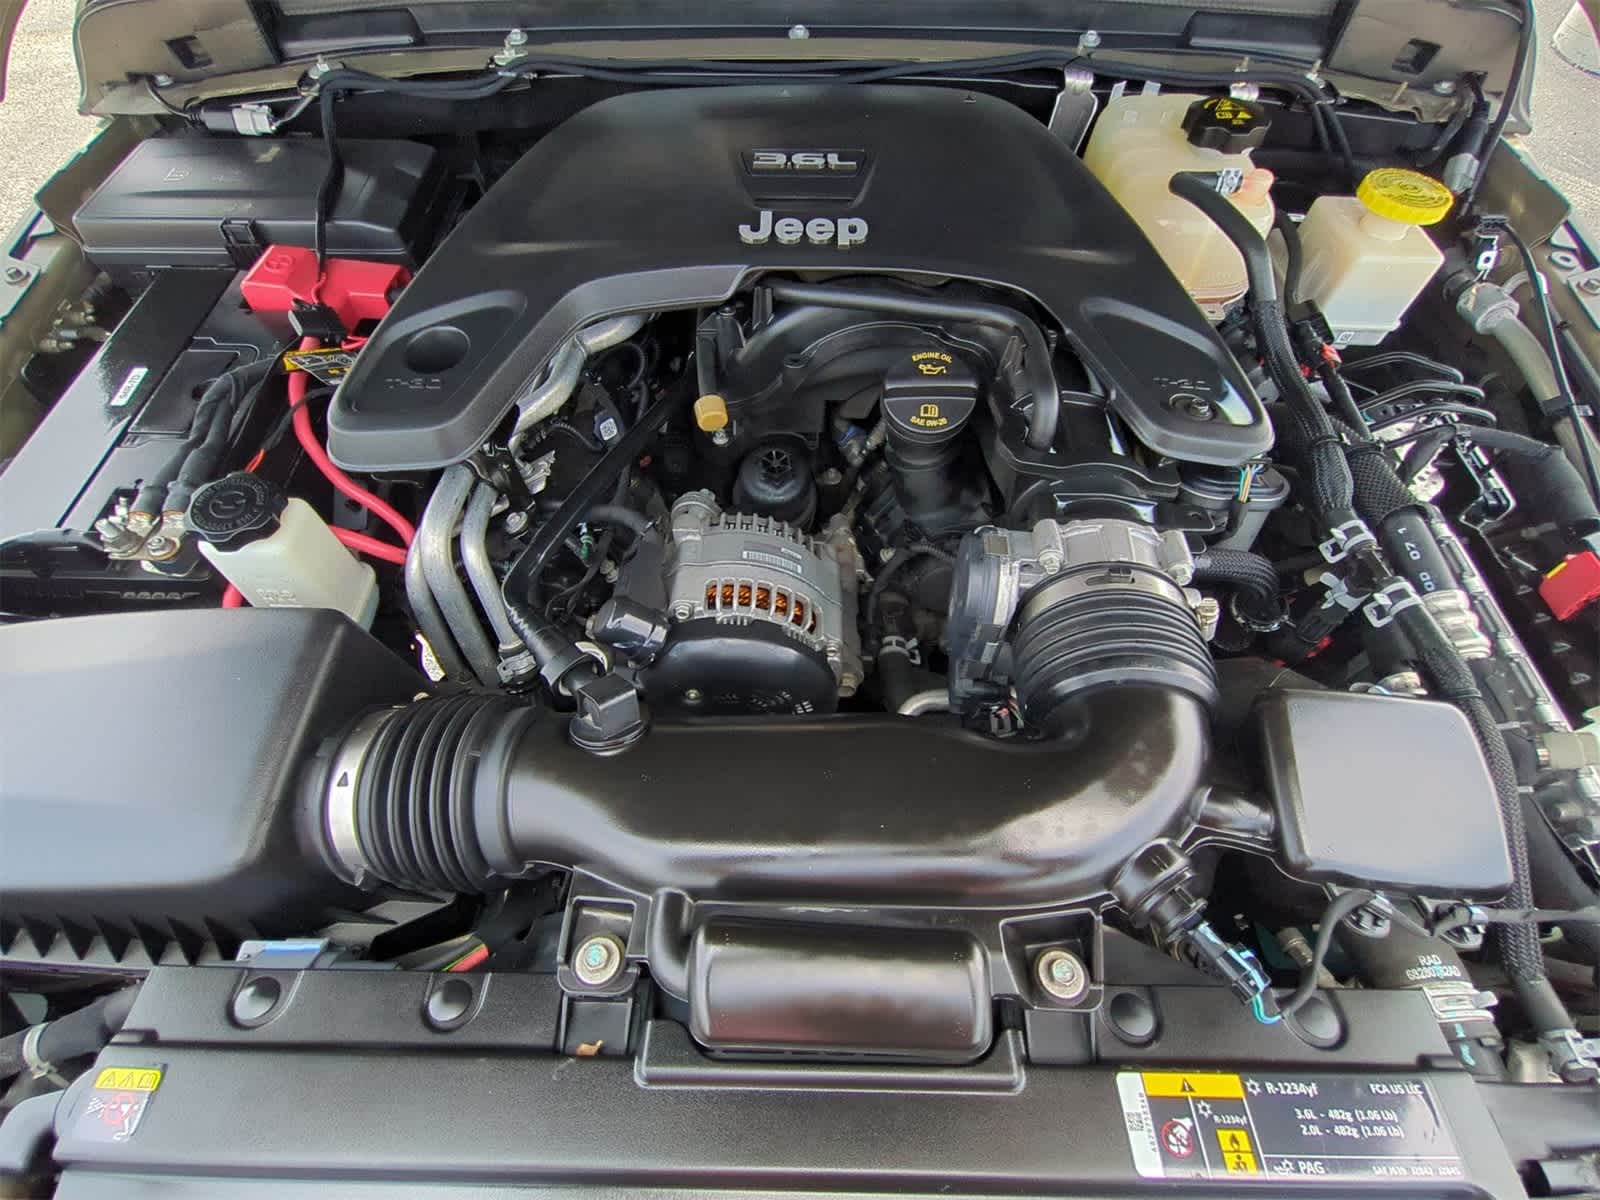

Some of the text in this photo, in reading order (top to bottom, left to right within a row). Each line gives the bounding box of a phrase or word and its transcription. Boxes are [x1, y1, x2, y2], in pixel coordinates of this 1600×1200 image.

[752, 152, 857, 169] 3.6L
[738, 210, 869, 249] Jeep
[911, 351, 953, 364] ENGINE OIL
[1417, 953, 1443, 967] RAD
[1264, 1081, 1319, 1098] R-1234yf
[1368, 1083, 1391, 1094] FCA
[1390, 1083, 1405, 1094] US
[1293, 1107, 1319, 1120] 3.6L
[1327, 1108, 1354, 1123] 482g
[1300, 1123, 1324, 1136] 2.0L
[1333, 1124, 1360, 1139] 482g
[1297, 1160, 1326, 1175] PAG
